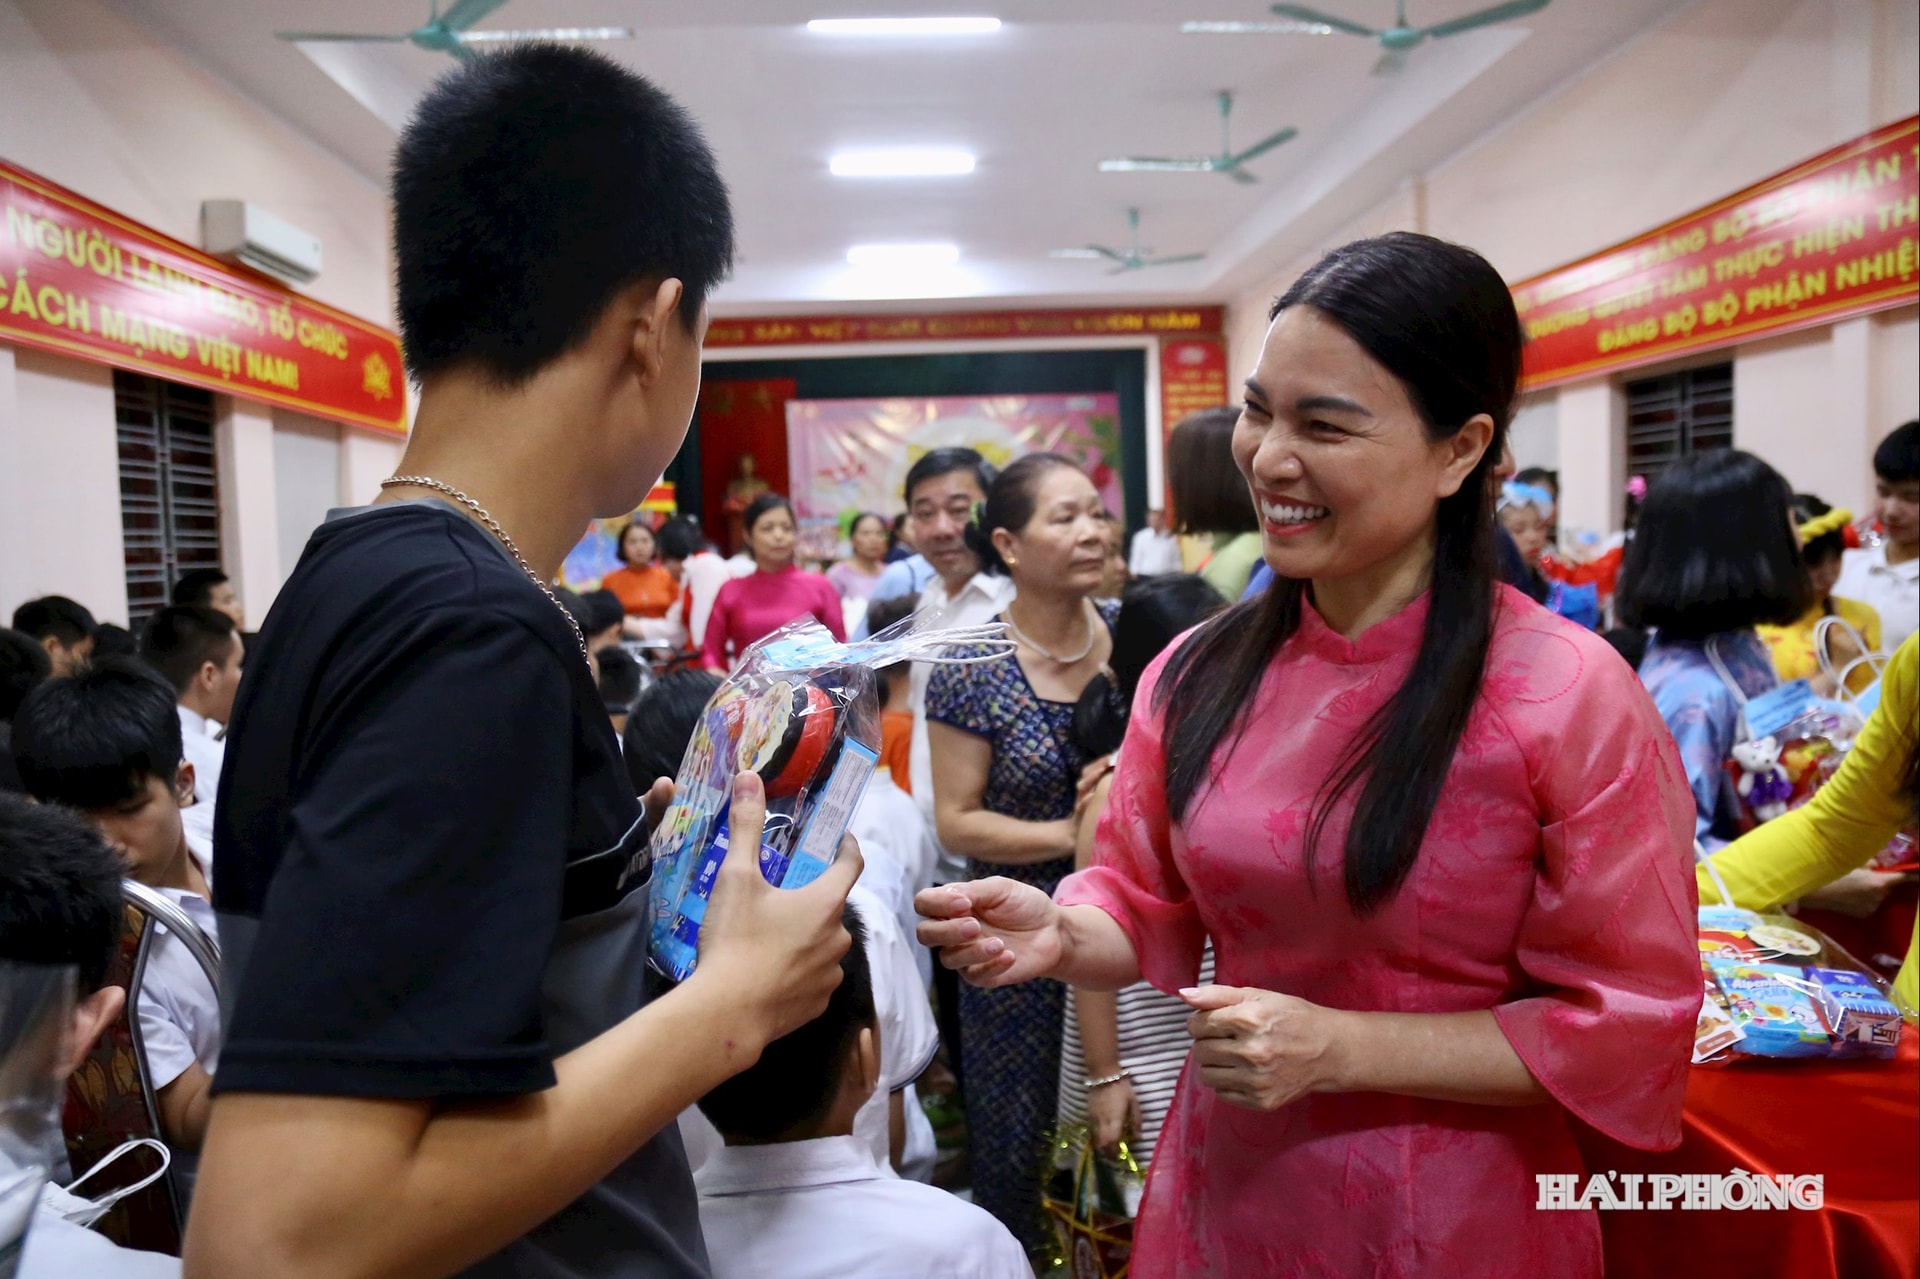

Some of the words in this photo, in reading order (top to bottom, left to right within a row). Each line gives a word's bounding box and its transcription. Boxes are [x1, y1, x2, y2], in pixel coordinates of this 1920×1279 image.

[6, 204, 123, 280] NGƯỜI
[1702, 292, 1740, 326] BỘ
[1745, 269, 1827, 313] PHẬN
[1835, 237, 1919, 290] NHIỆ
[101, 303, 189, 360] MẠNG
[195, 331, 241, 381] VIỆT
[246, 349, 299, 391] NAM!
